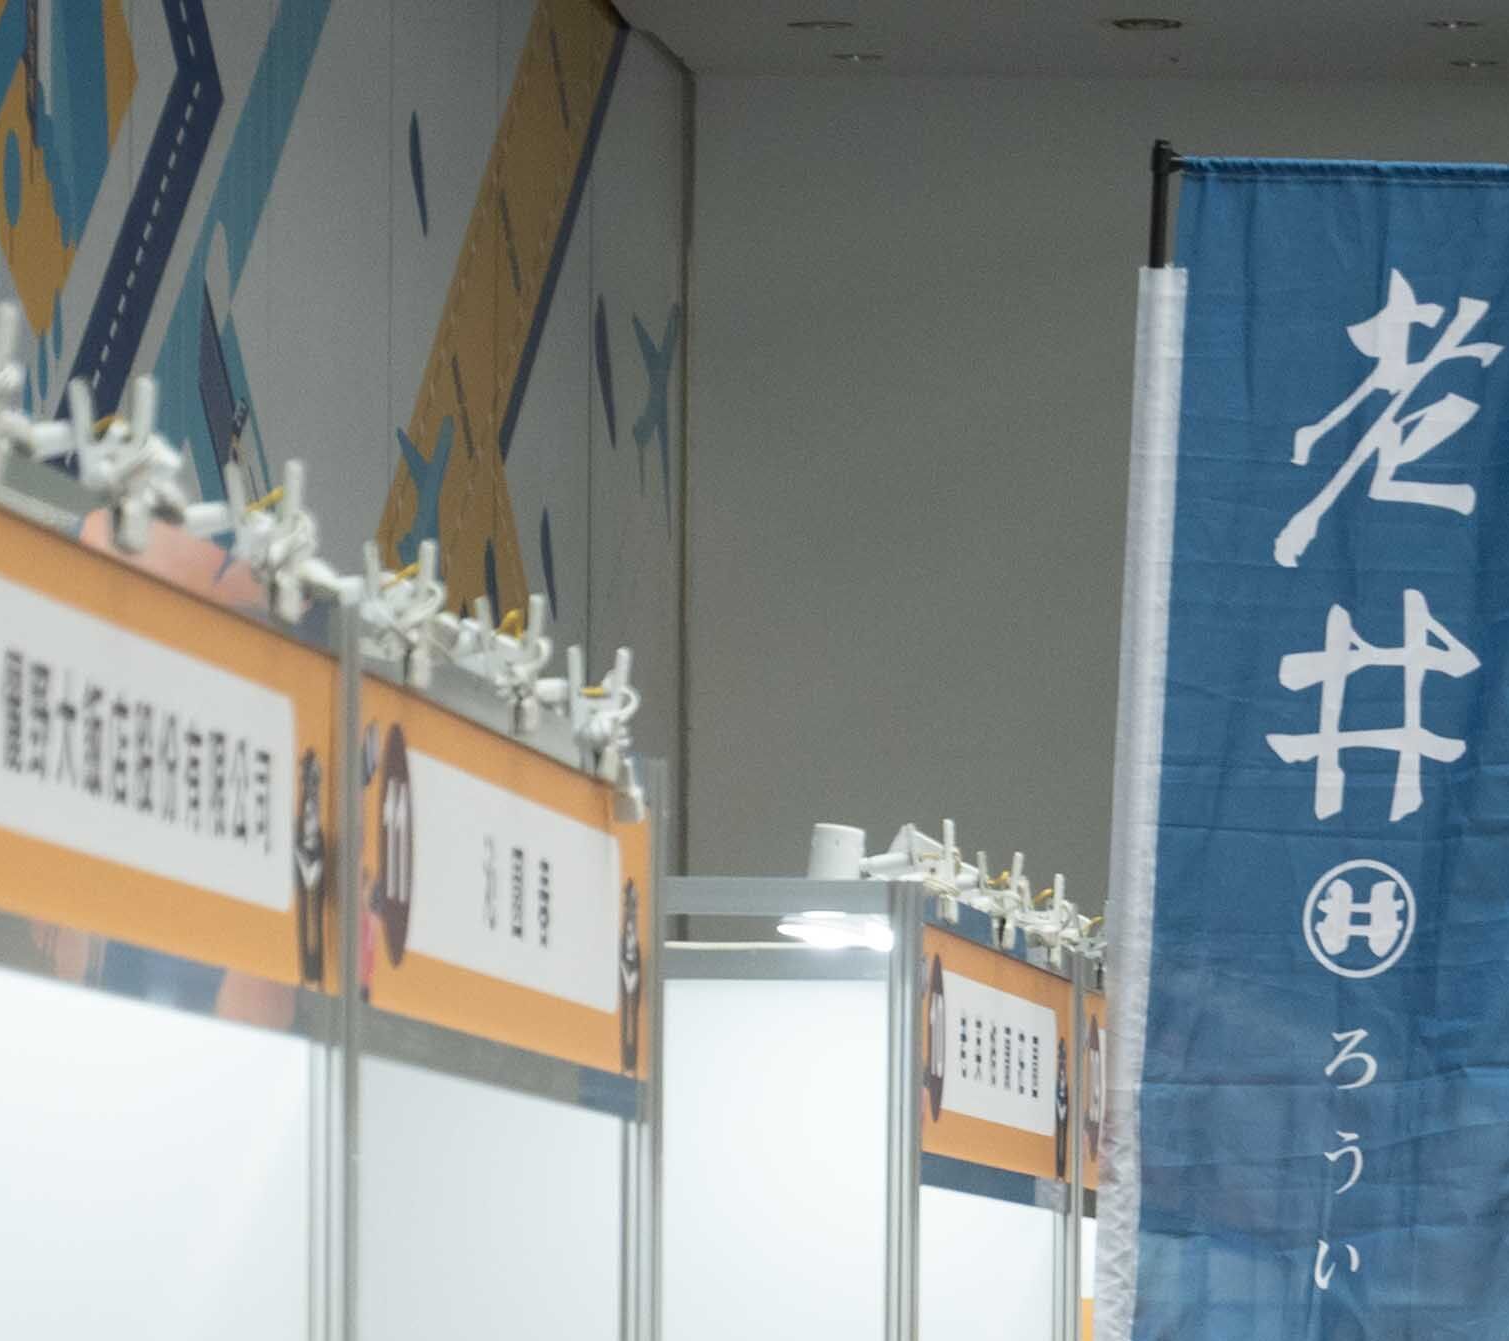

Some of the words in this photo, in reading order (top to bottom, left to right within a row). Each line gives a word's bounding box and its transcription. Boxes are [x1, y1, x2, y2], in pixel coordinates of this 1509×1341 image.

[383, 776, 408, 904] 11
[1313, 1027, 1379, 1291] ろうい
